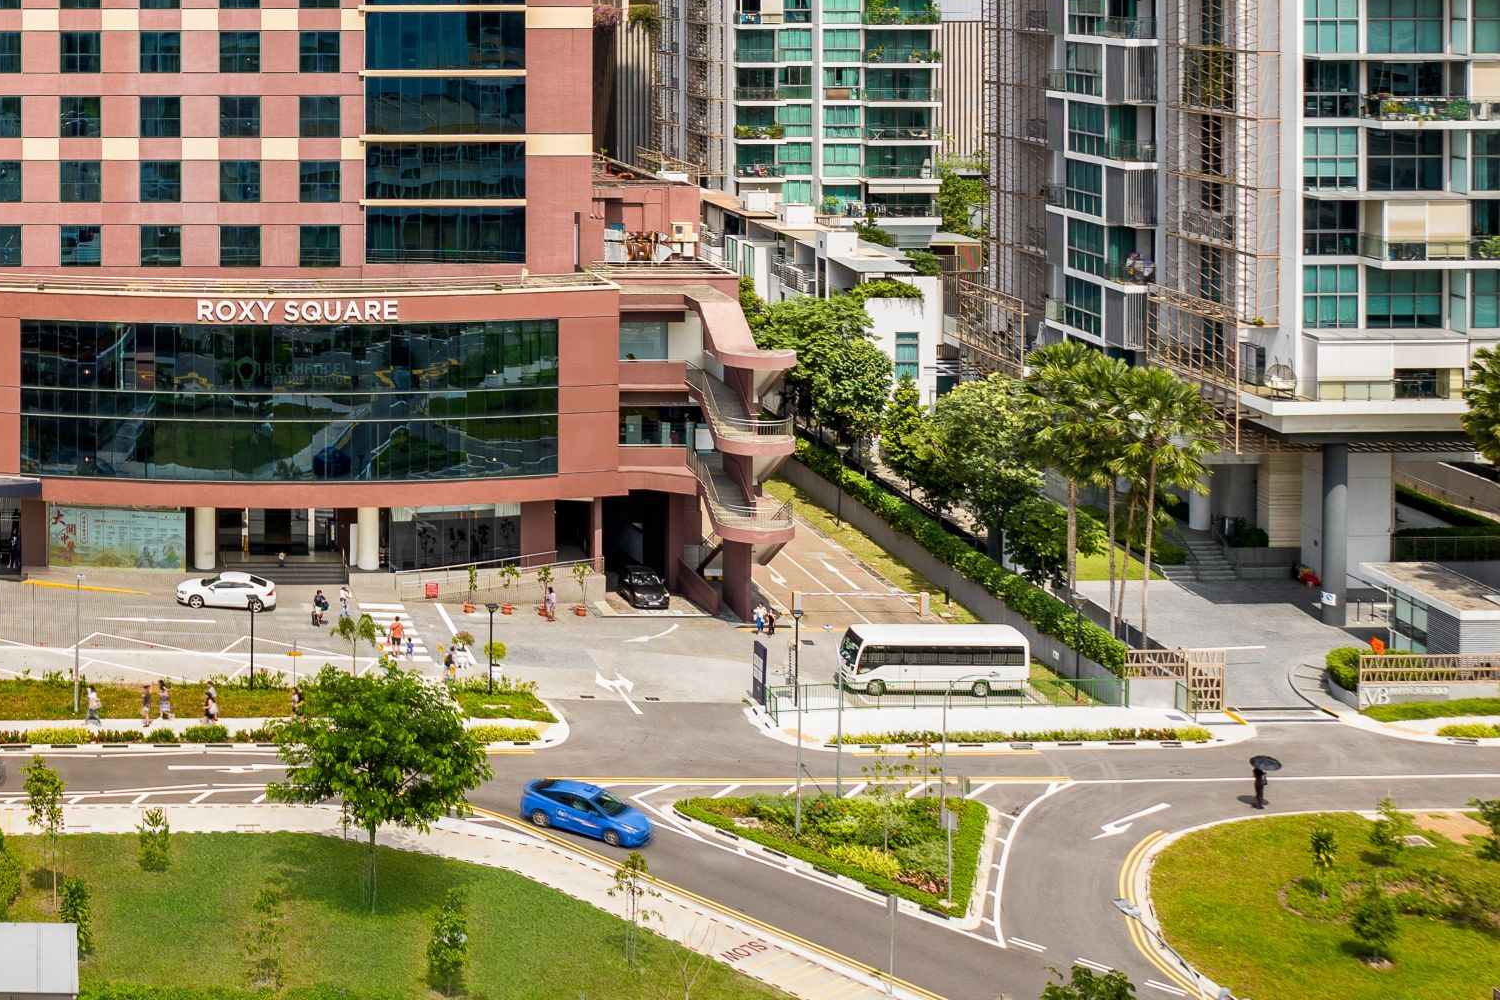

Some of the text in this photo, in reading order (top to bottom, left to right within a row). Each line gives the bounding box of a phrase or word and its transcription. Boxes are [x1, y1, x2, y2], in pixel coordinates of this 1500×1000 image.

[197, 300, 399, 322] ROXY SQUARE
[264, 363, 282, 374] RG
[720, 941, 768, 963] SLOW
